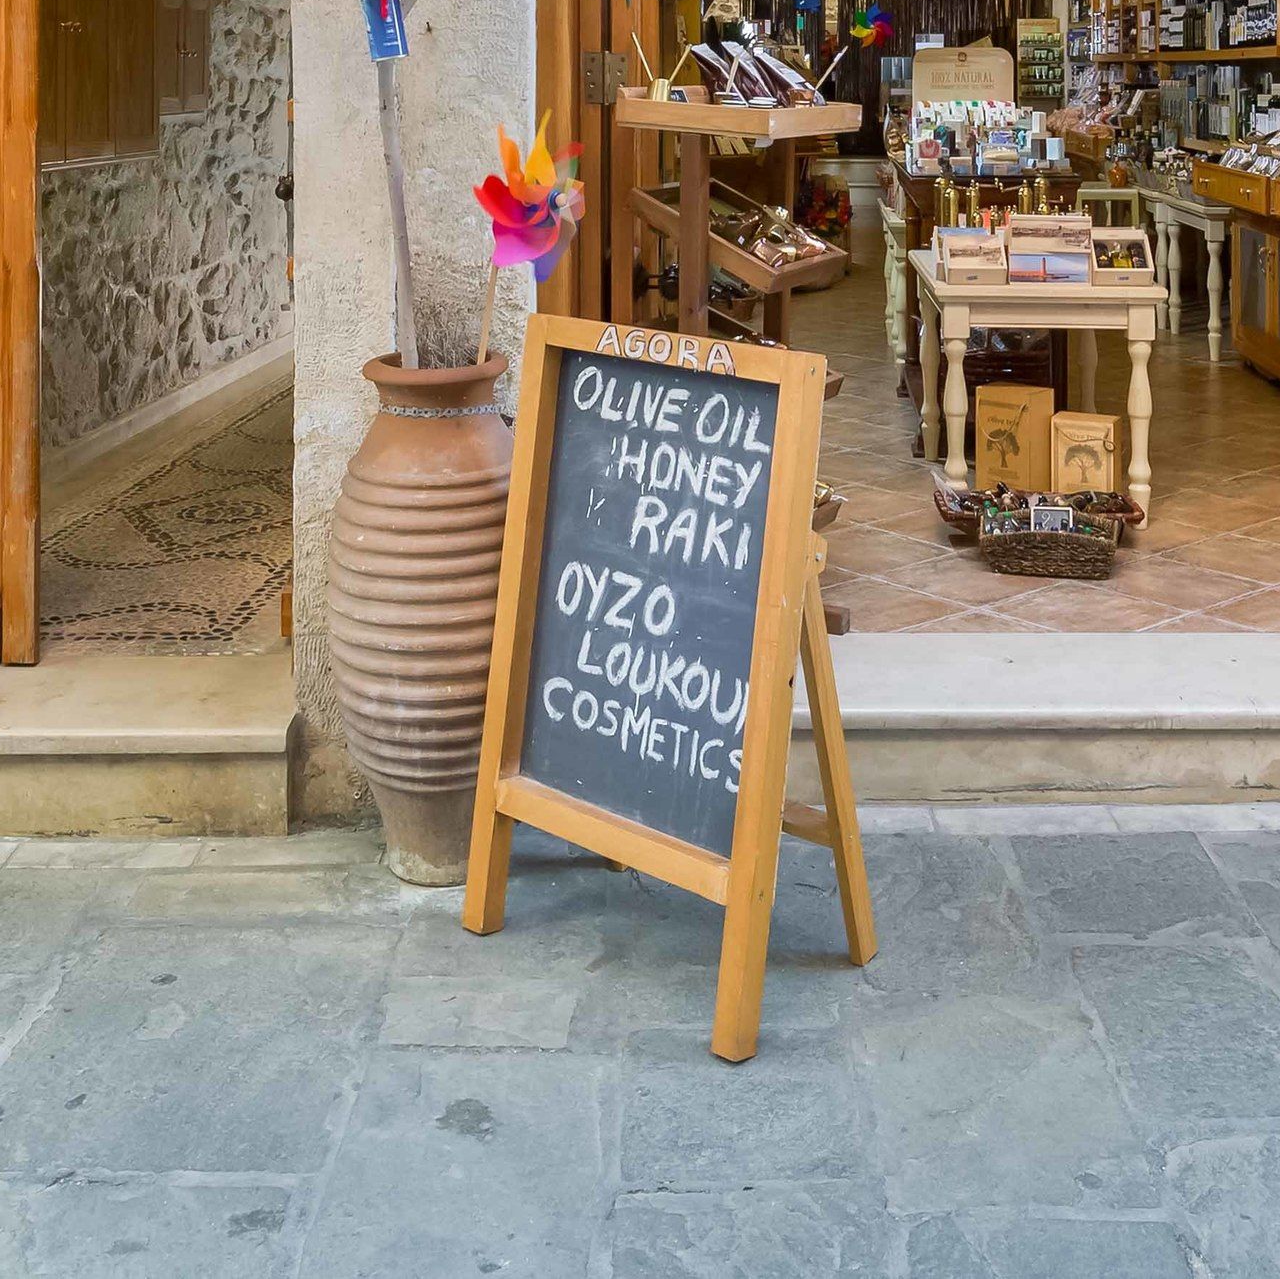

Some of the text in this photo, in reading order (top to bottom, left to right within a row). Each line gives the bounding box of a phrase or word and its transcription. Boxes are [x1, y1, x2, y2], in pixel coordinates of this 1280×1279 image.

[595, 325, 736, 377] AGORA
[573, 366, 771, 453] OLIVE OIL
[617, 434, 763, 509] HONEY
[630, 494, 752, 570] RAKI
[556, 561, 676, 637] OYZO
[577, 630, 750, 736] LOUKOU
[542, 676, 744, 794] COSMETICS
